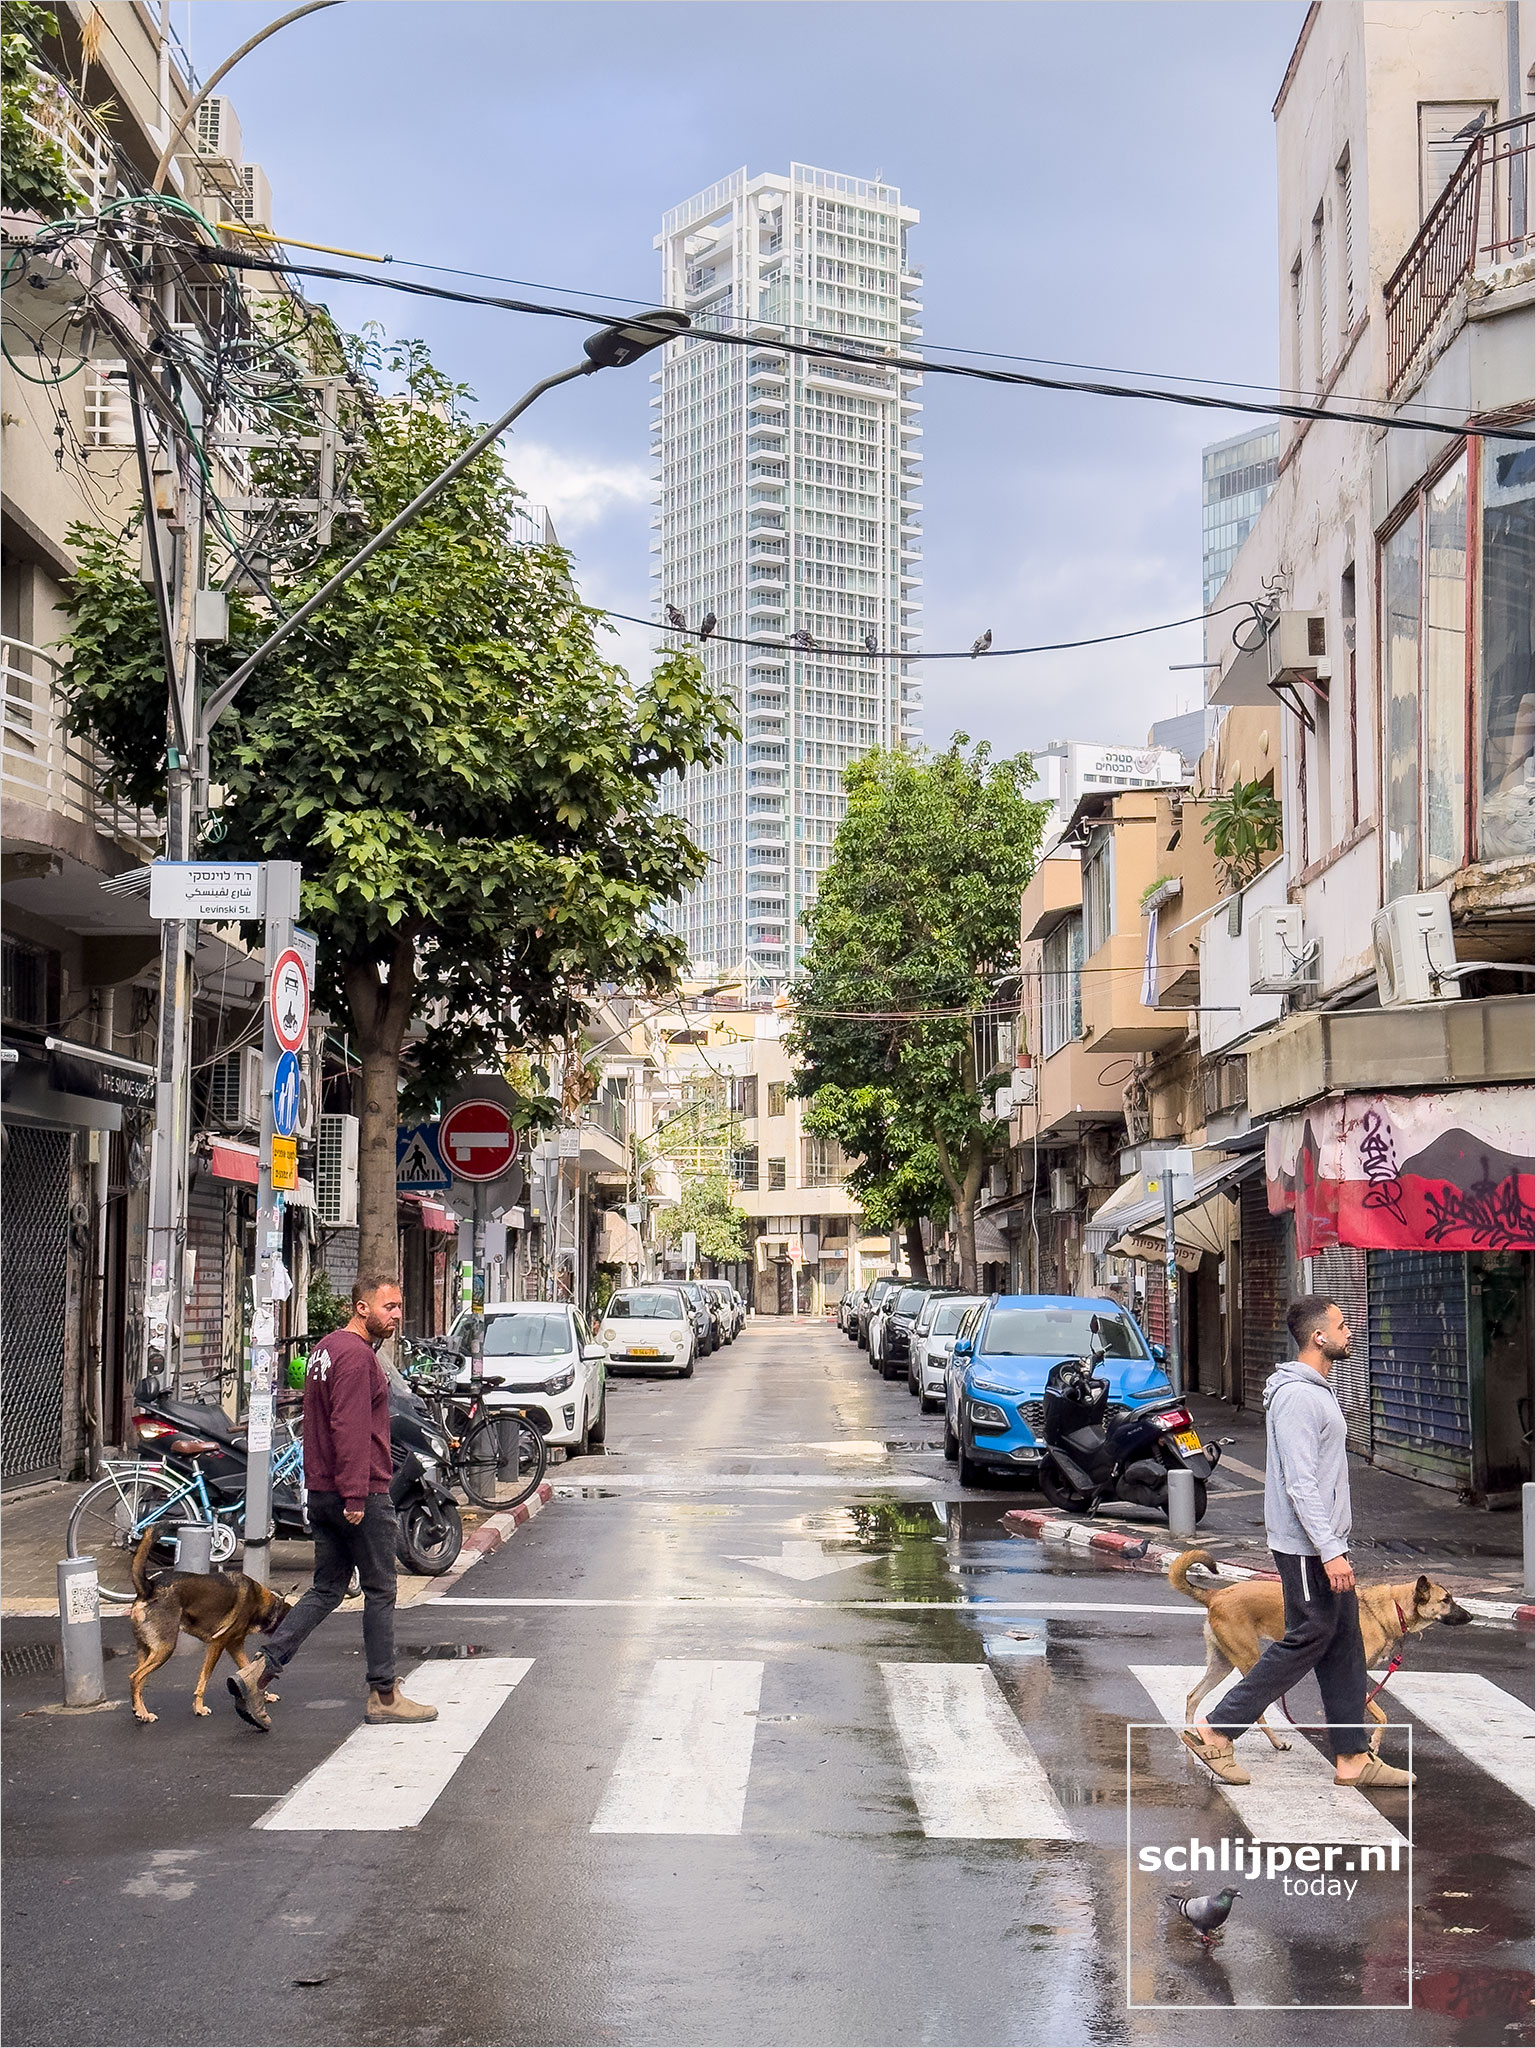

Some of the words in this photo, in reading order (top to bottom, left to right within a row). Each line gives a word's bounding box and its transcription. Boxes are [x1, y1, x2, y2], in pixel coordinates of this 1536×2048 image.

[1095, 762, 1133, 773] מבטחים
[188, 871, 231, 883] לוינסקי
[231, 888, 252, 899] شارع
[199, 905, 237, 914] Levinski
[238, 905, 251, 914] St.
[103, 1074, 114, 1092] THE
